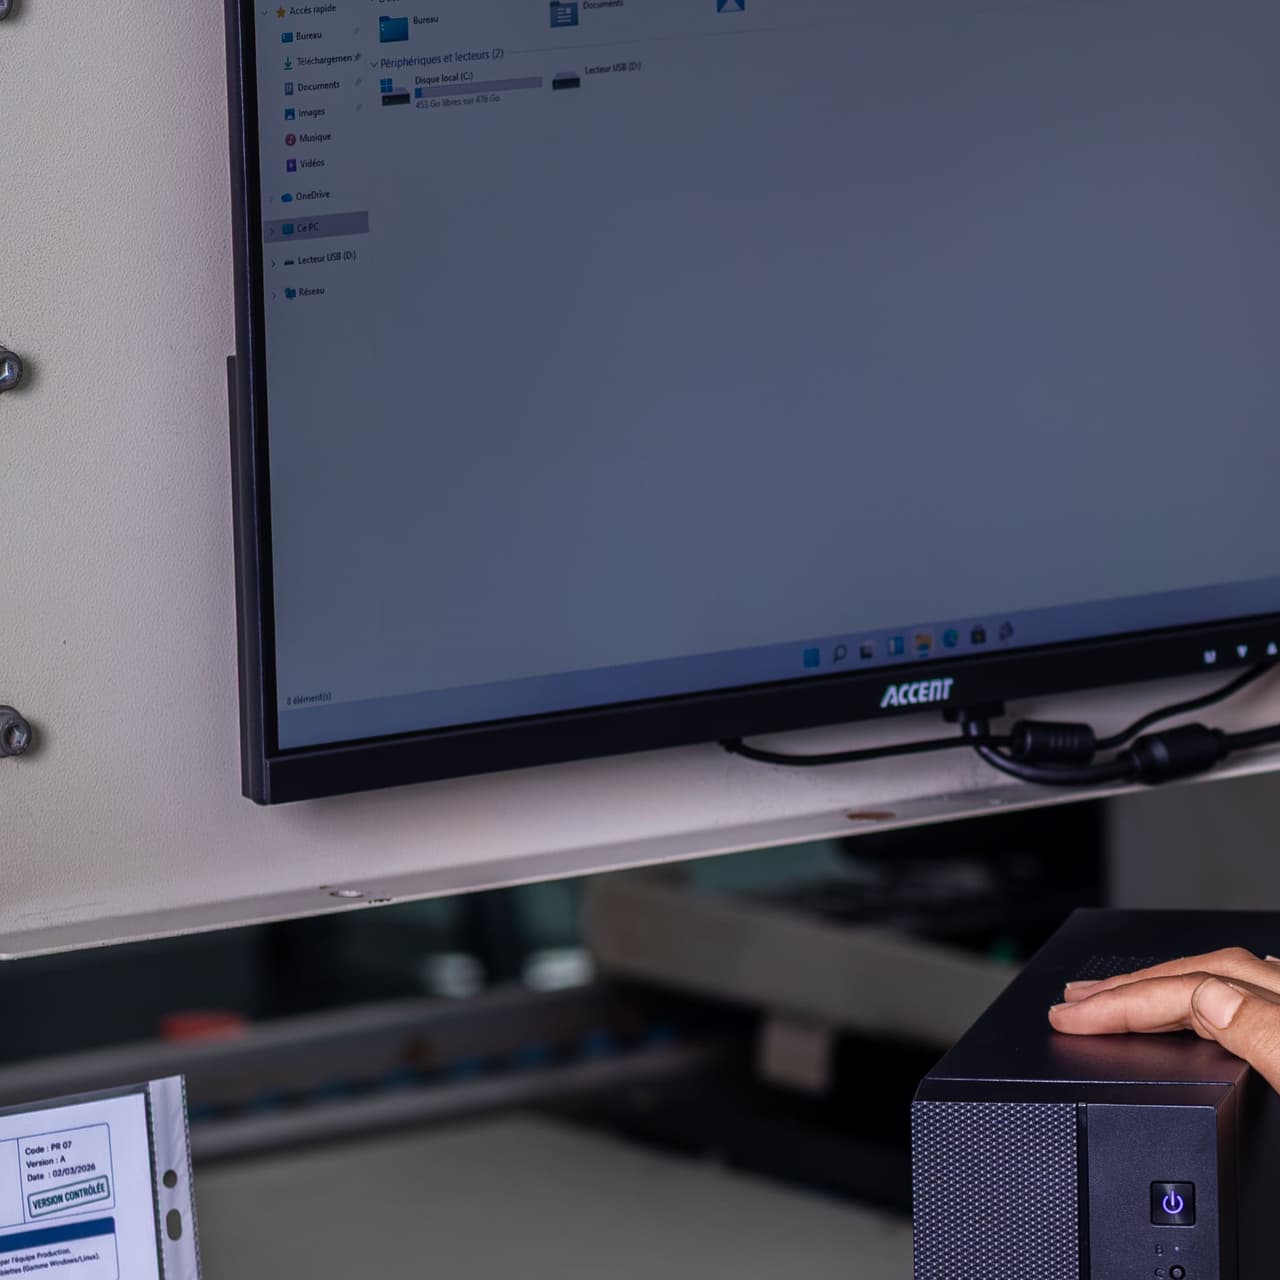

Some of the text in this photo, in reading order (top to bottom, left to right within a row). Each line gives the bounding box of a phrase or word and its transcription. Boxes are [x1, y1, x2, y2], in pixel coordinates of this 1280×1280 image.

[313, 4, 336, 14] rapide
[413, 16, 439, 25] Bureau
[296, 31, 322, 41] Bureau
[381, 48, 504, 69] Périphériques et lecteurs (2)
[585, 65, 611, 75] Lecteur
[612, 63, 628, 72] USB
[415, 71, 473, 85] Disque local (C:)
[298, 81, 340, 92] Documents
[299, 109, 326, 118] Images
[300, 133, 331, 143] Musique
[300, 159, 325, 169] Vidéos
[296, 190, 330, 201] OneDrive
[297, 222, 319, 232] Ce PC
[298, 256, 325, 265] Lecteur
[326, 252, 342, 262] USB
[299, 287, 325, 297] Réseau
[880, 677, 954, 708] ACCENT
[25, 1146, 45, 1156] Code
[51, 1142, 61, 1151] PR
[62, 1140, 72, 1149] 07
[26, 1157, 54, 1168] Version
[60, 1155, 66, 1163] A
[27, 1173, 45, 1182] Date
[32, 1182, 105, 1210] VERSION CONTRÔLÉE
